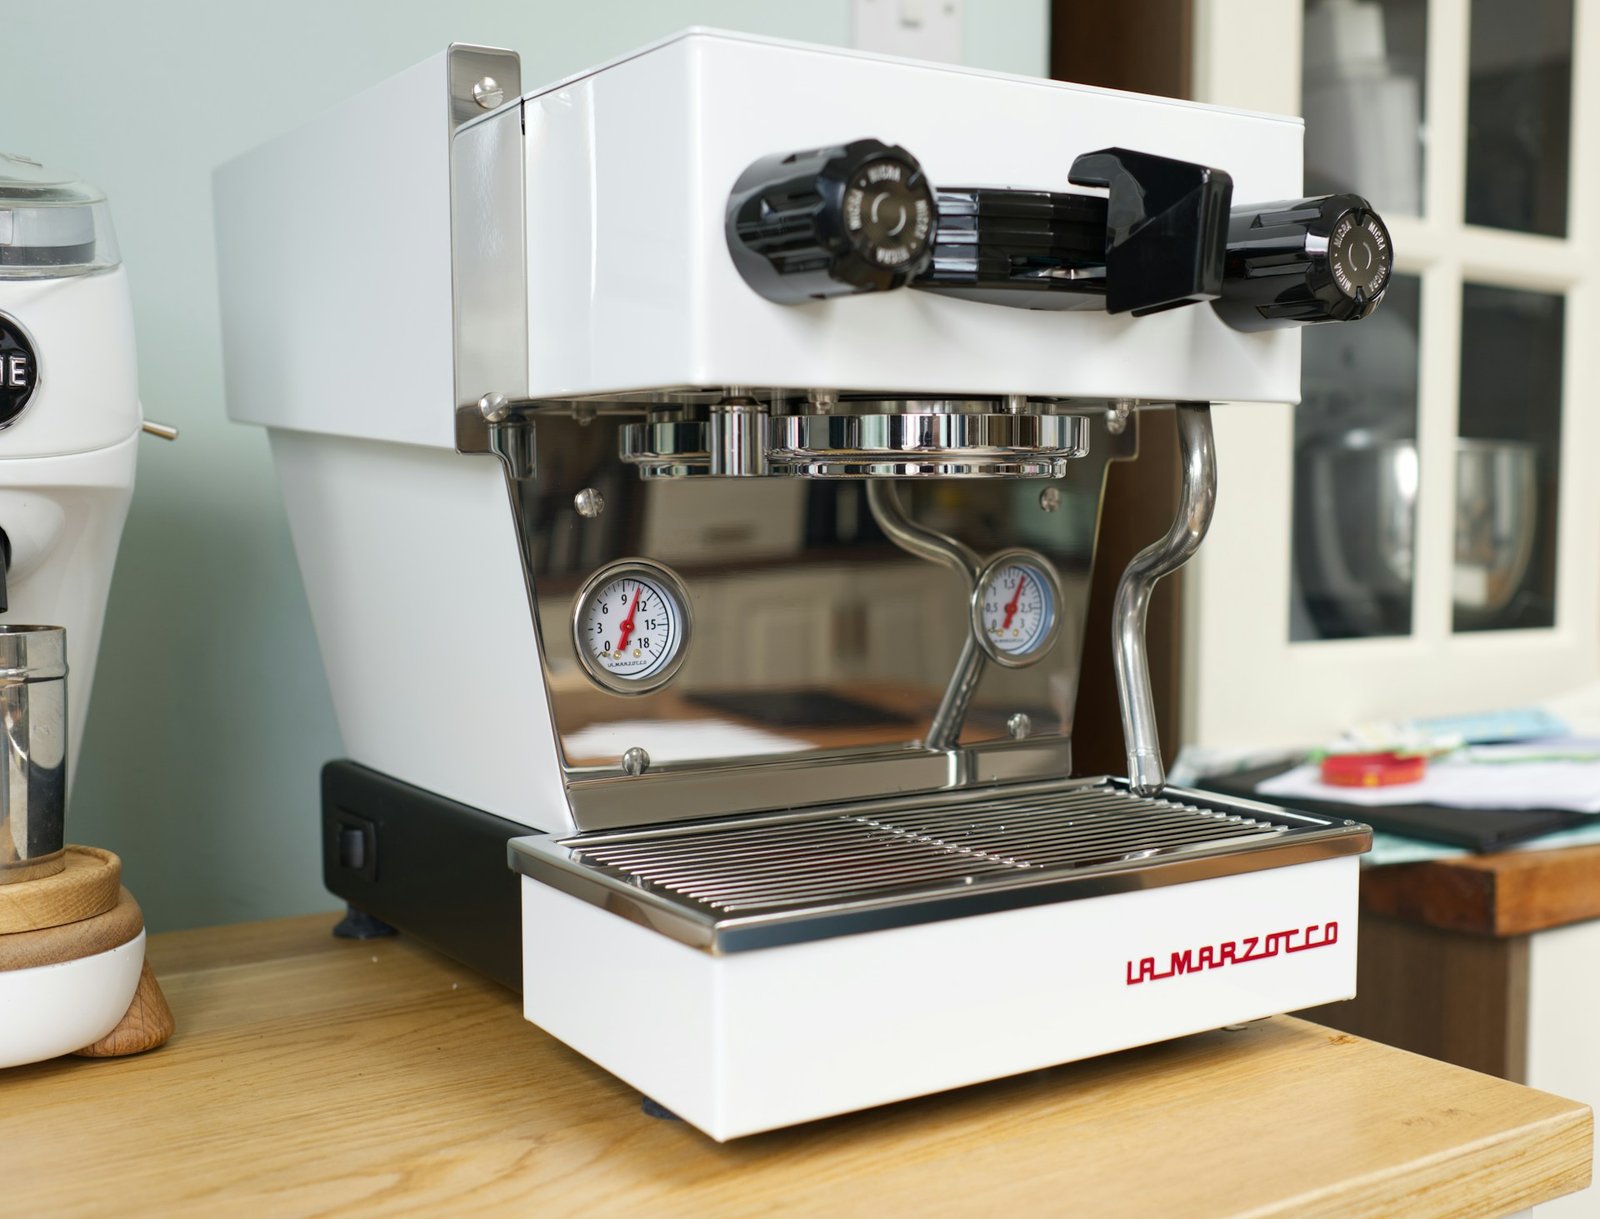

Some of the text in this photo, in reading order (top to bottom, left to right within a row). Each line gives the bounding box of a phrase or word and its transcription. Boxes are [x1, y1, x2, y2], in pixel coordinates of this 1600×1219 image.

[868, 165, 900, 183] MICRA
[1333, 220, 1352, 248] MICRA
[1368, 221, 1386, 251] MICRA
[1334, 262, 1352, 292] MICRA
[1369, 265, 1386, 292] MICRA
[621, 594, 628, 605] 9
[602, 603, 609, 614] 6
[636, 601, 647, 612] 12
[597, 623, 603, 634] 3
[645, 619, 656, 630] 15
[604, 640, 611, 651] 0
[638, 637, 650, 649] 18
[1171, 921, 1338, 975] MARZOCCO
